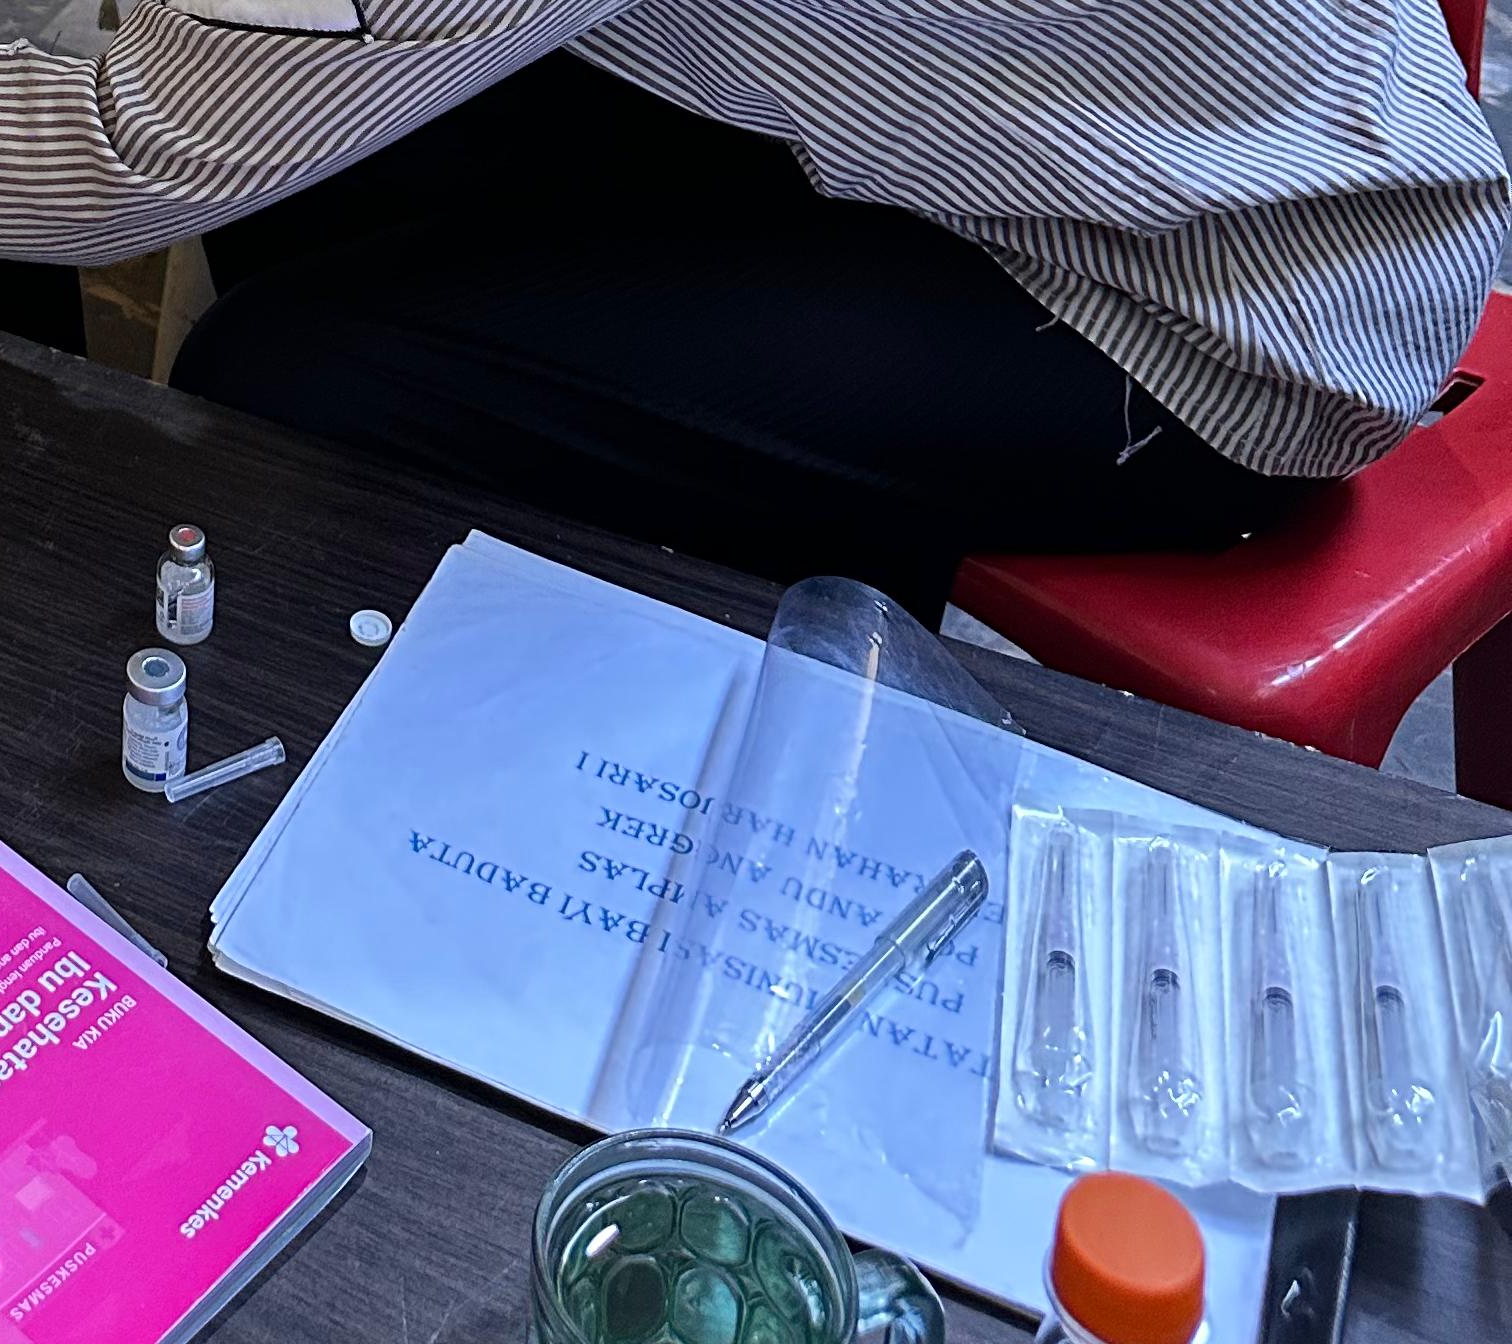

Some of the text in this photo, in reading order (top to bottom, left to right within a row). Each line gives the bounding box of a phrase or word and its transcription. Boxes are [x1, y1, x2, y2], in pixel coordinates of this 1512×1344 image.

[409, 831, 551, 905] BADUTA
[10, 938, 30, 956] dan
[559, 894, 651, 945] BAYI
[18, 937, 62, 972] Panduan
[38, 951, 91, 993] Ibu
[737, 908, 964, 1013] PUSESMAS
[72, 995, 137, 1050] BUKU KIA
[180, 1151, 271, 1238] Kemenkes
[10, 1243, 96, 1321] PUSKESMAS
